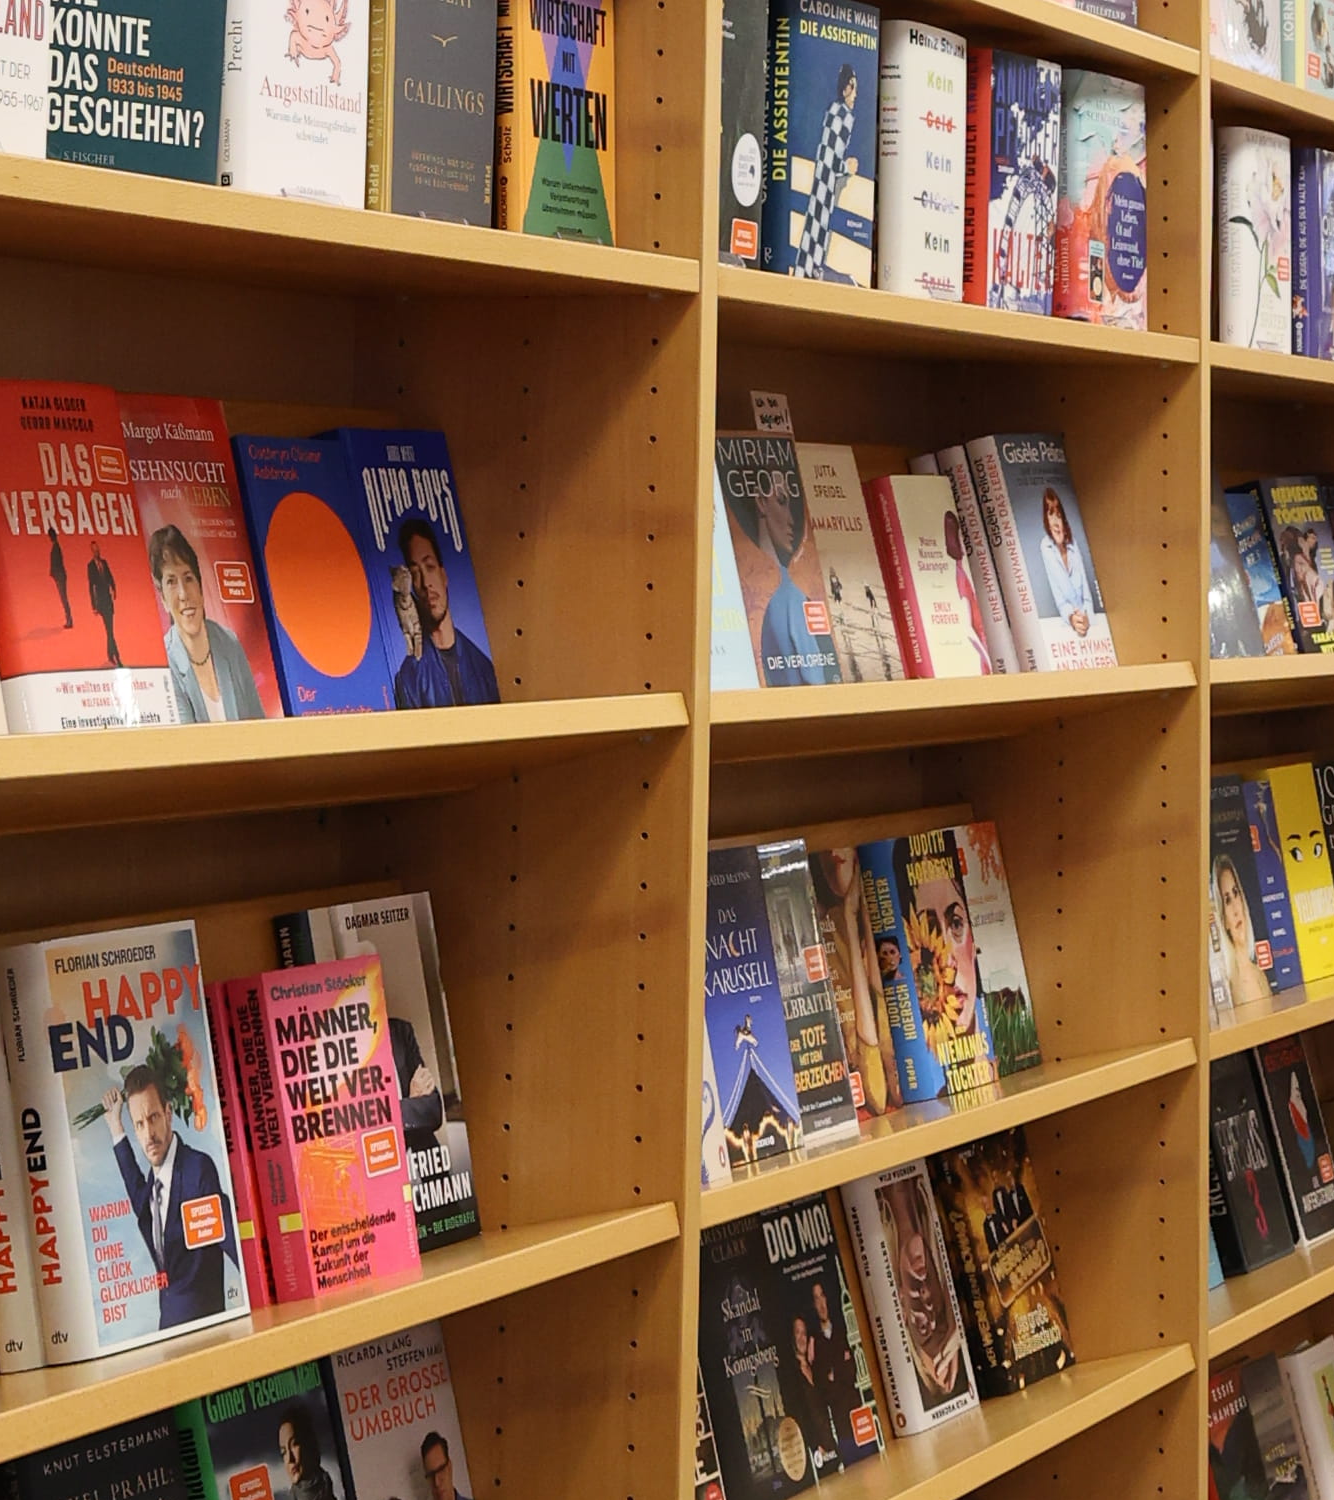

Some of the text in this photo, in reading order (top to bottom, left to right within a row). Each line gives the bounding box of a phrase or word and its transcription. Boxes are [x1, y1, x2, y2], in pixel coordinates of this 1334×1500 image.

[50, 8, 151, 57] KONNTE
[800, 19, 877, 51] DIE ASSISTENTIN
[1283, 0, 1295, 42] KORN
[9, 61, 31, 81] DER
[107, 57, 185, 83] Deutschland
[927, 70, 953, 94] Kein
[0, 491, 139, 538] VERSAGEN
[812, 516, 862, 533] AMARYLLIS
[767, 651, 835, 671] DIE VERLORENE
[908, 829, 946, 858] JUDITH
[55, 944, 155, 975] FLORIAN SCHROEDER
[48, 1013, 134, 1073] END
[799, 1024, 826, 1048] TOTE
[938, 1032, 990, 1067] NIEMANDS
[763, 1203, 833, 1264] DIO MIO!
[103, 1304, 128, 1325] BIST
[721, 1288, 761, 1322] Skandal
